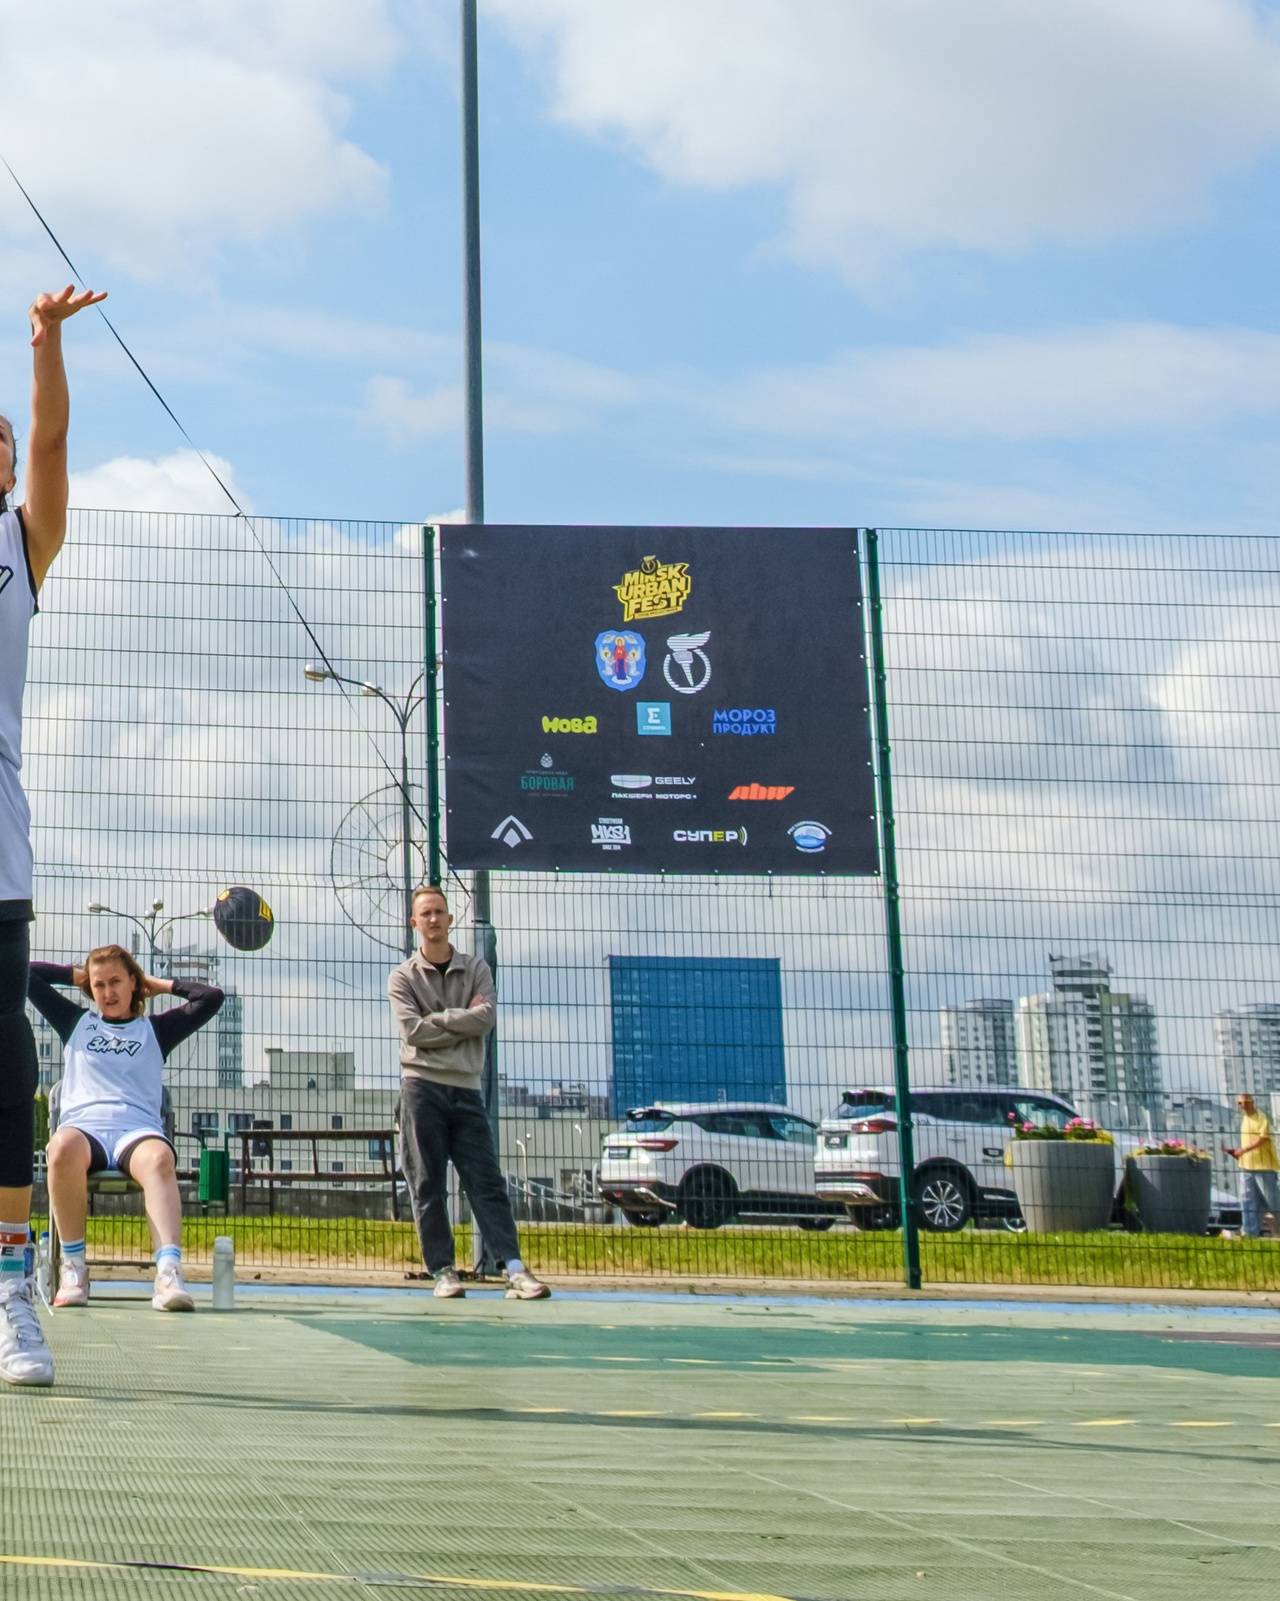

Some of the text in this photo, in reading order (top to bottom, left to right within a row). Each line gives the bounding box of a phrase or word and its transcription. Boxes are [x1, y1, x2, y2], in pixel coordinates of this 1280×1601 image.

[620, 577, 687, 601] URBAN
[628, 591, 682, 617] FEST
[713, 708, 776, 723] МОРОЗ
[713, 723, 776, 737] ПРОДУКТ
[520, 775, 575, 791] БОРОВАЯ
[654, 776, 697, 786] GEELY
[673, 830, 739, 843] СУПЕР
